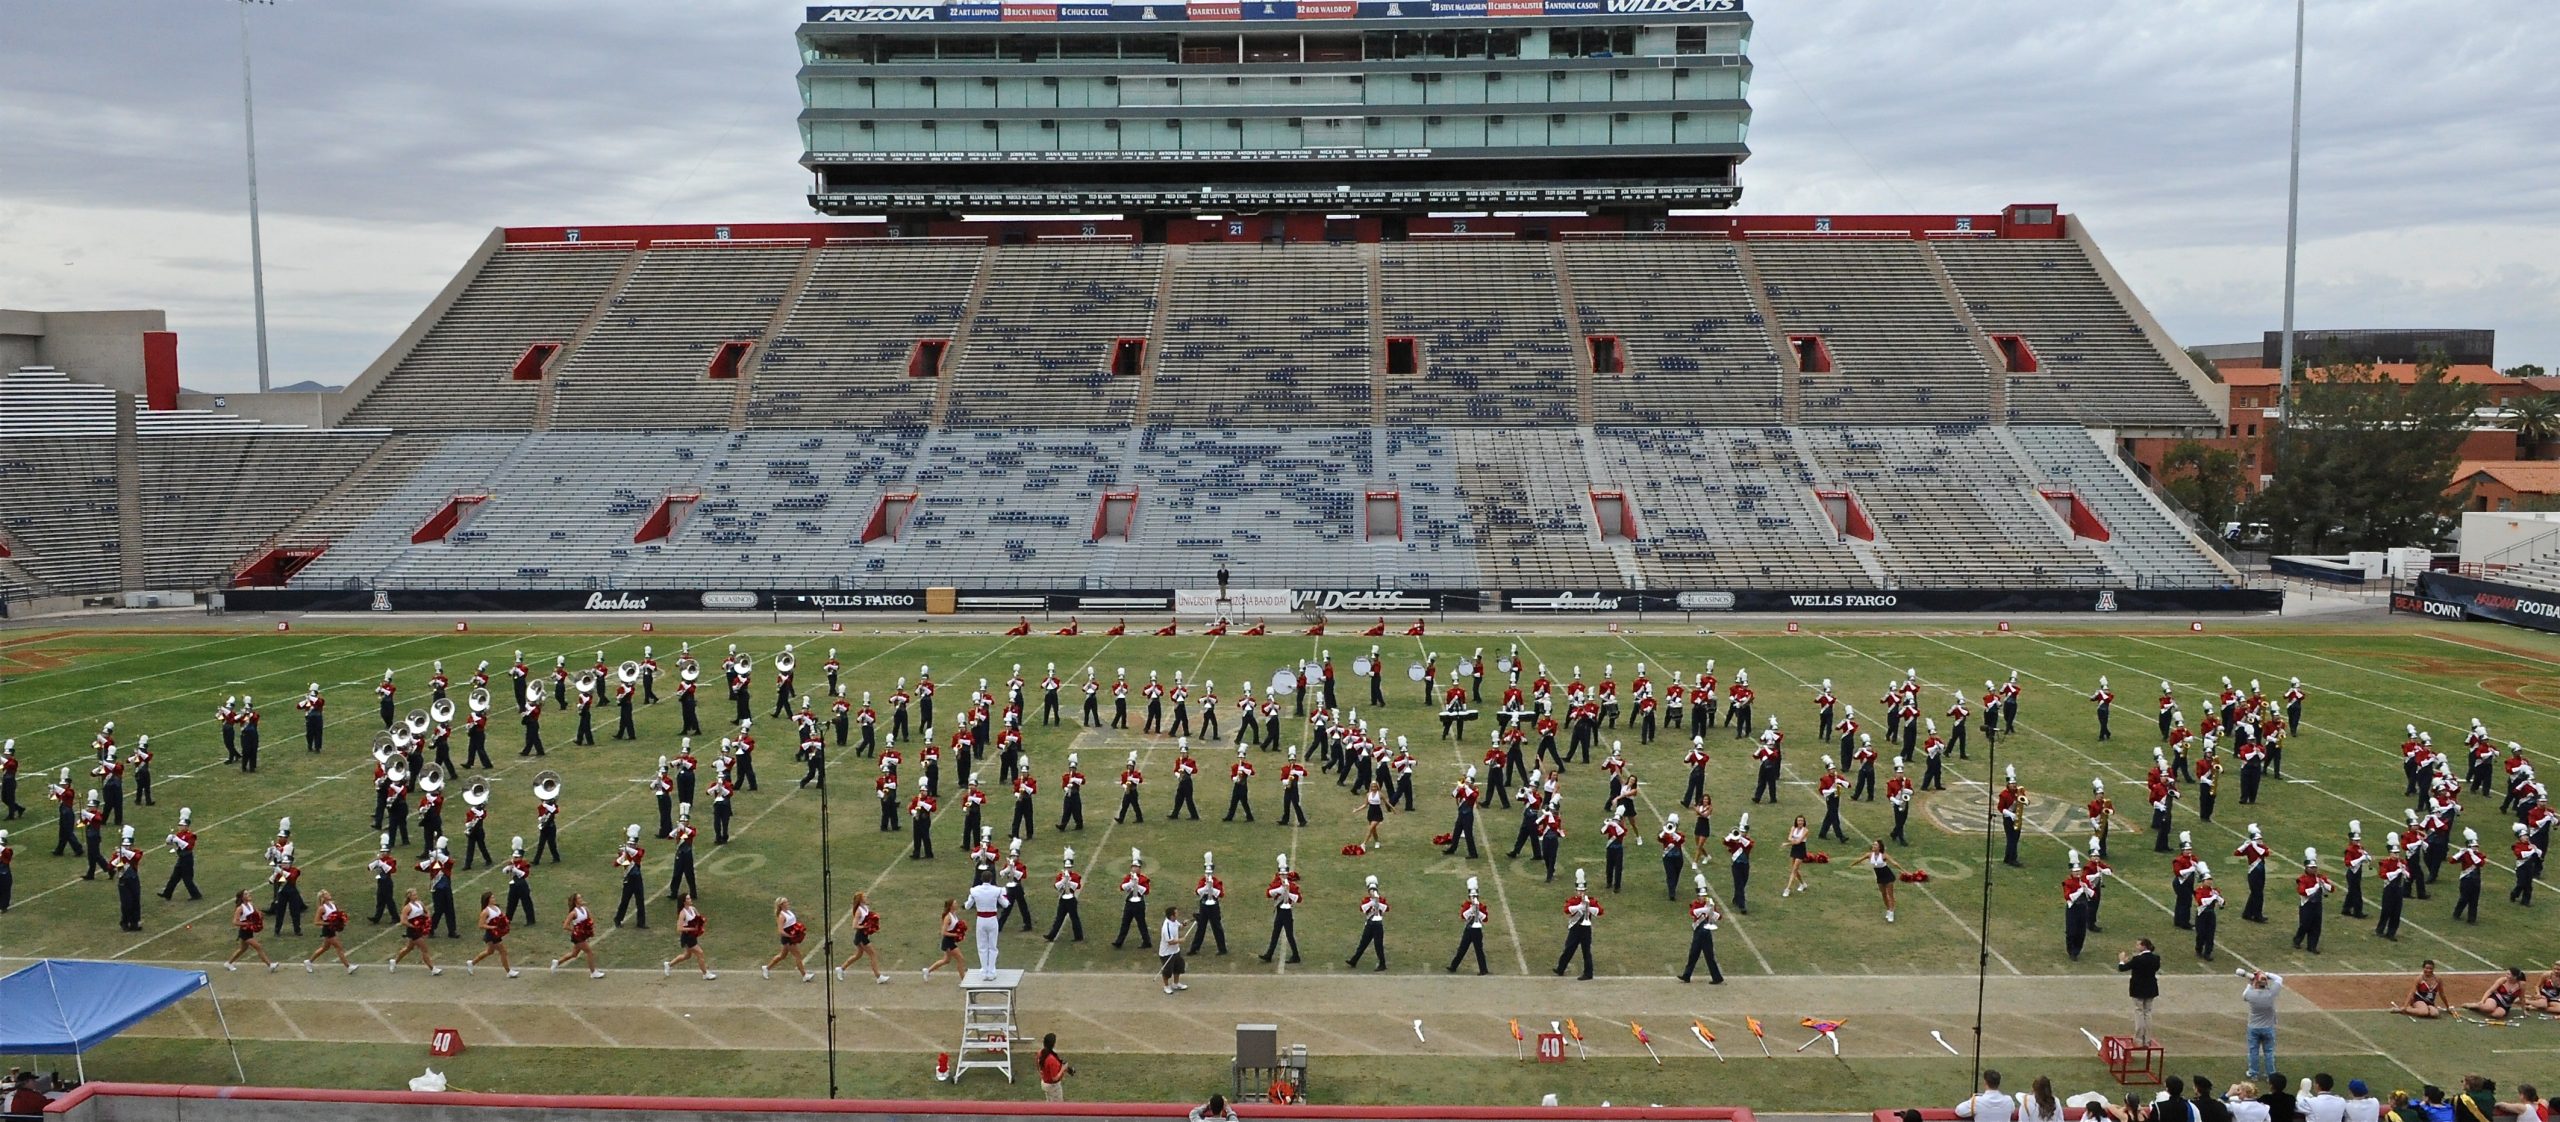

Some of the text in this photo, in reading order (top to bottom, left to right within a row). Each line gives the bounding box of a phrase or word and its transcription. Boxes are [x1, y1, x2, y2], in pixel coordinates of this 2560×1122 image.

[1306, 6, 1319, 14] ROB
[1320, 6, 1351, 14] WALDROP
[1494, 3, 1511, 11] CHRIS
[1550, 2, 1576, 10] ANTOINE
[1577, 2, 1598, 10] CASON
[1607, 0, 1736, 13] WILDCATS
[820, 8, 935, 22] ARIZONA
[950, 8, 958, 16] 22
[1222, 7, 1240, 15] LEWIS
[1230, 226, 1241, 235] 21
[1454, 224, 1466, 233] 22
[1654, 222, 1666, 232] 23
[1817, 222, 1829, 232] 24
[1958, 222, 1970, 231] 25
[717, 231, 729, 240] 18
[1082, 227, 1095, 236] 20
[568, 234, 578, 242] 17
[216, 398, 225, 406] 16
[585, 592, 649, 610] Bashas'
[811, 594, 914, 606] WELLS FARGO
[1179, 596, 1213, 606] UNIVERSITY
[1255, 596, 1273, 606] BAND
[1274, 596, 1288, 606] DAY
[1790, 595, 1897, 606] WELLS FARGO
[433, 1032, 451, 1052] 40
[1542, 1038, 1560, 1057] 40
